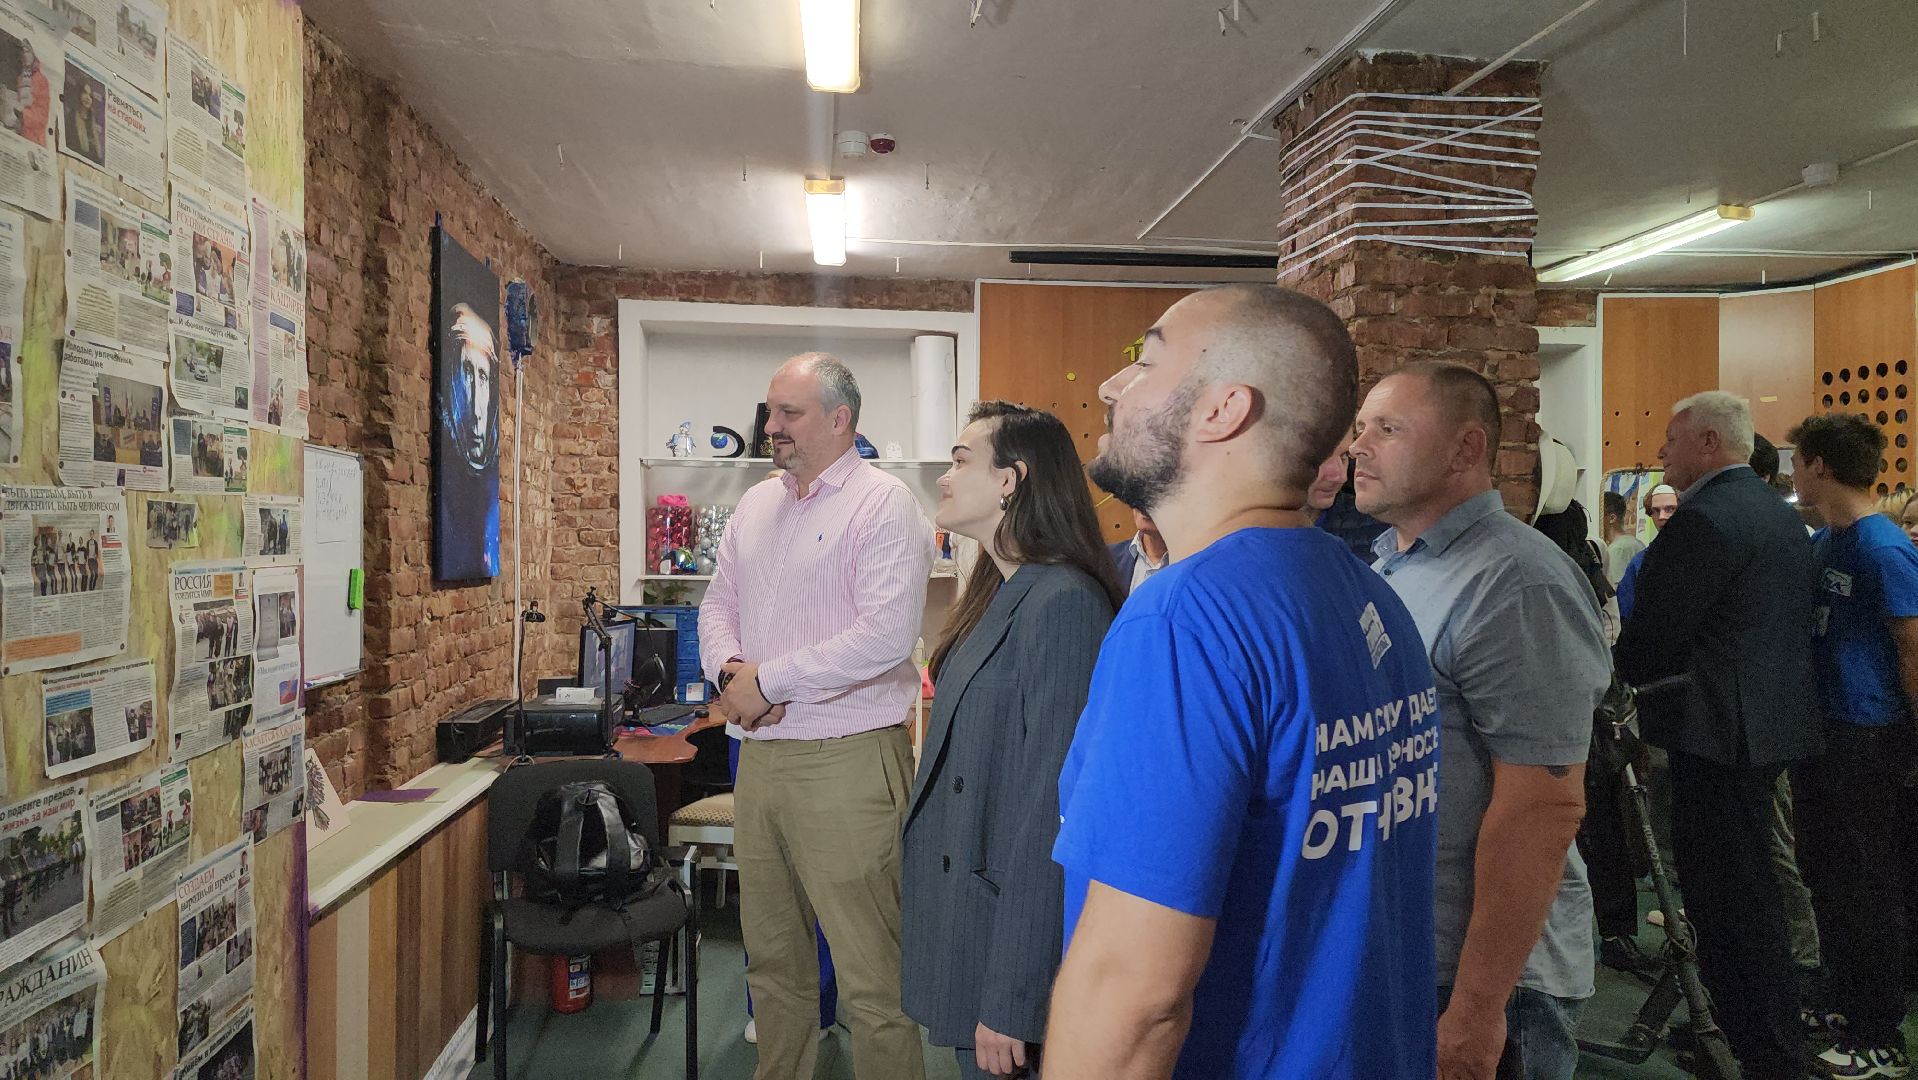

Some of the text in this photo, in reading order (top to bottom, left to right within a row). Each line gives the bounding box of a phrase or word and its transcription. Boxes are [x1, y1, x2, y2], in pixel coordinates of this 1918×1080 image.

[57, 501, 78, 511] БЫТЬ
[79, 501, 120, 512] ЧЕЛОВЕКОМ
[174, 574, 212, 591] РОССИЯ
[1315, 712, 1375, 756] НАМ
[7, 798, 41, 818] подвиге
[2, 817, 30, 832] жизнь
[31, 811, 41, 822] за
[42, 806, 59, 818] наш
